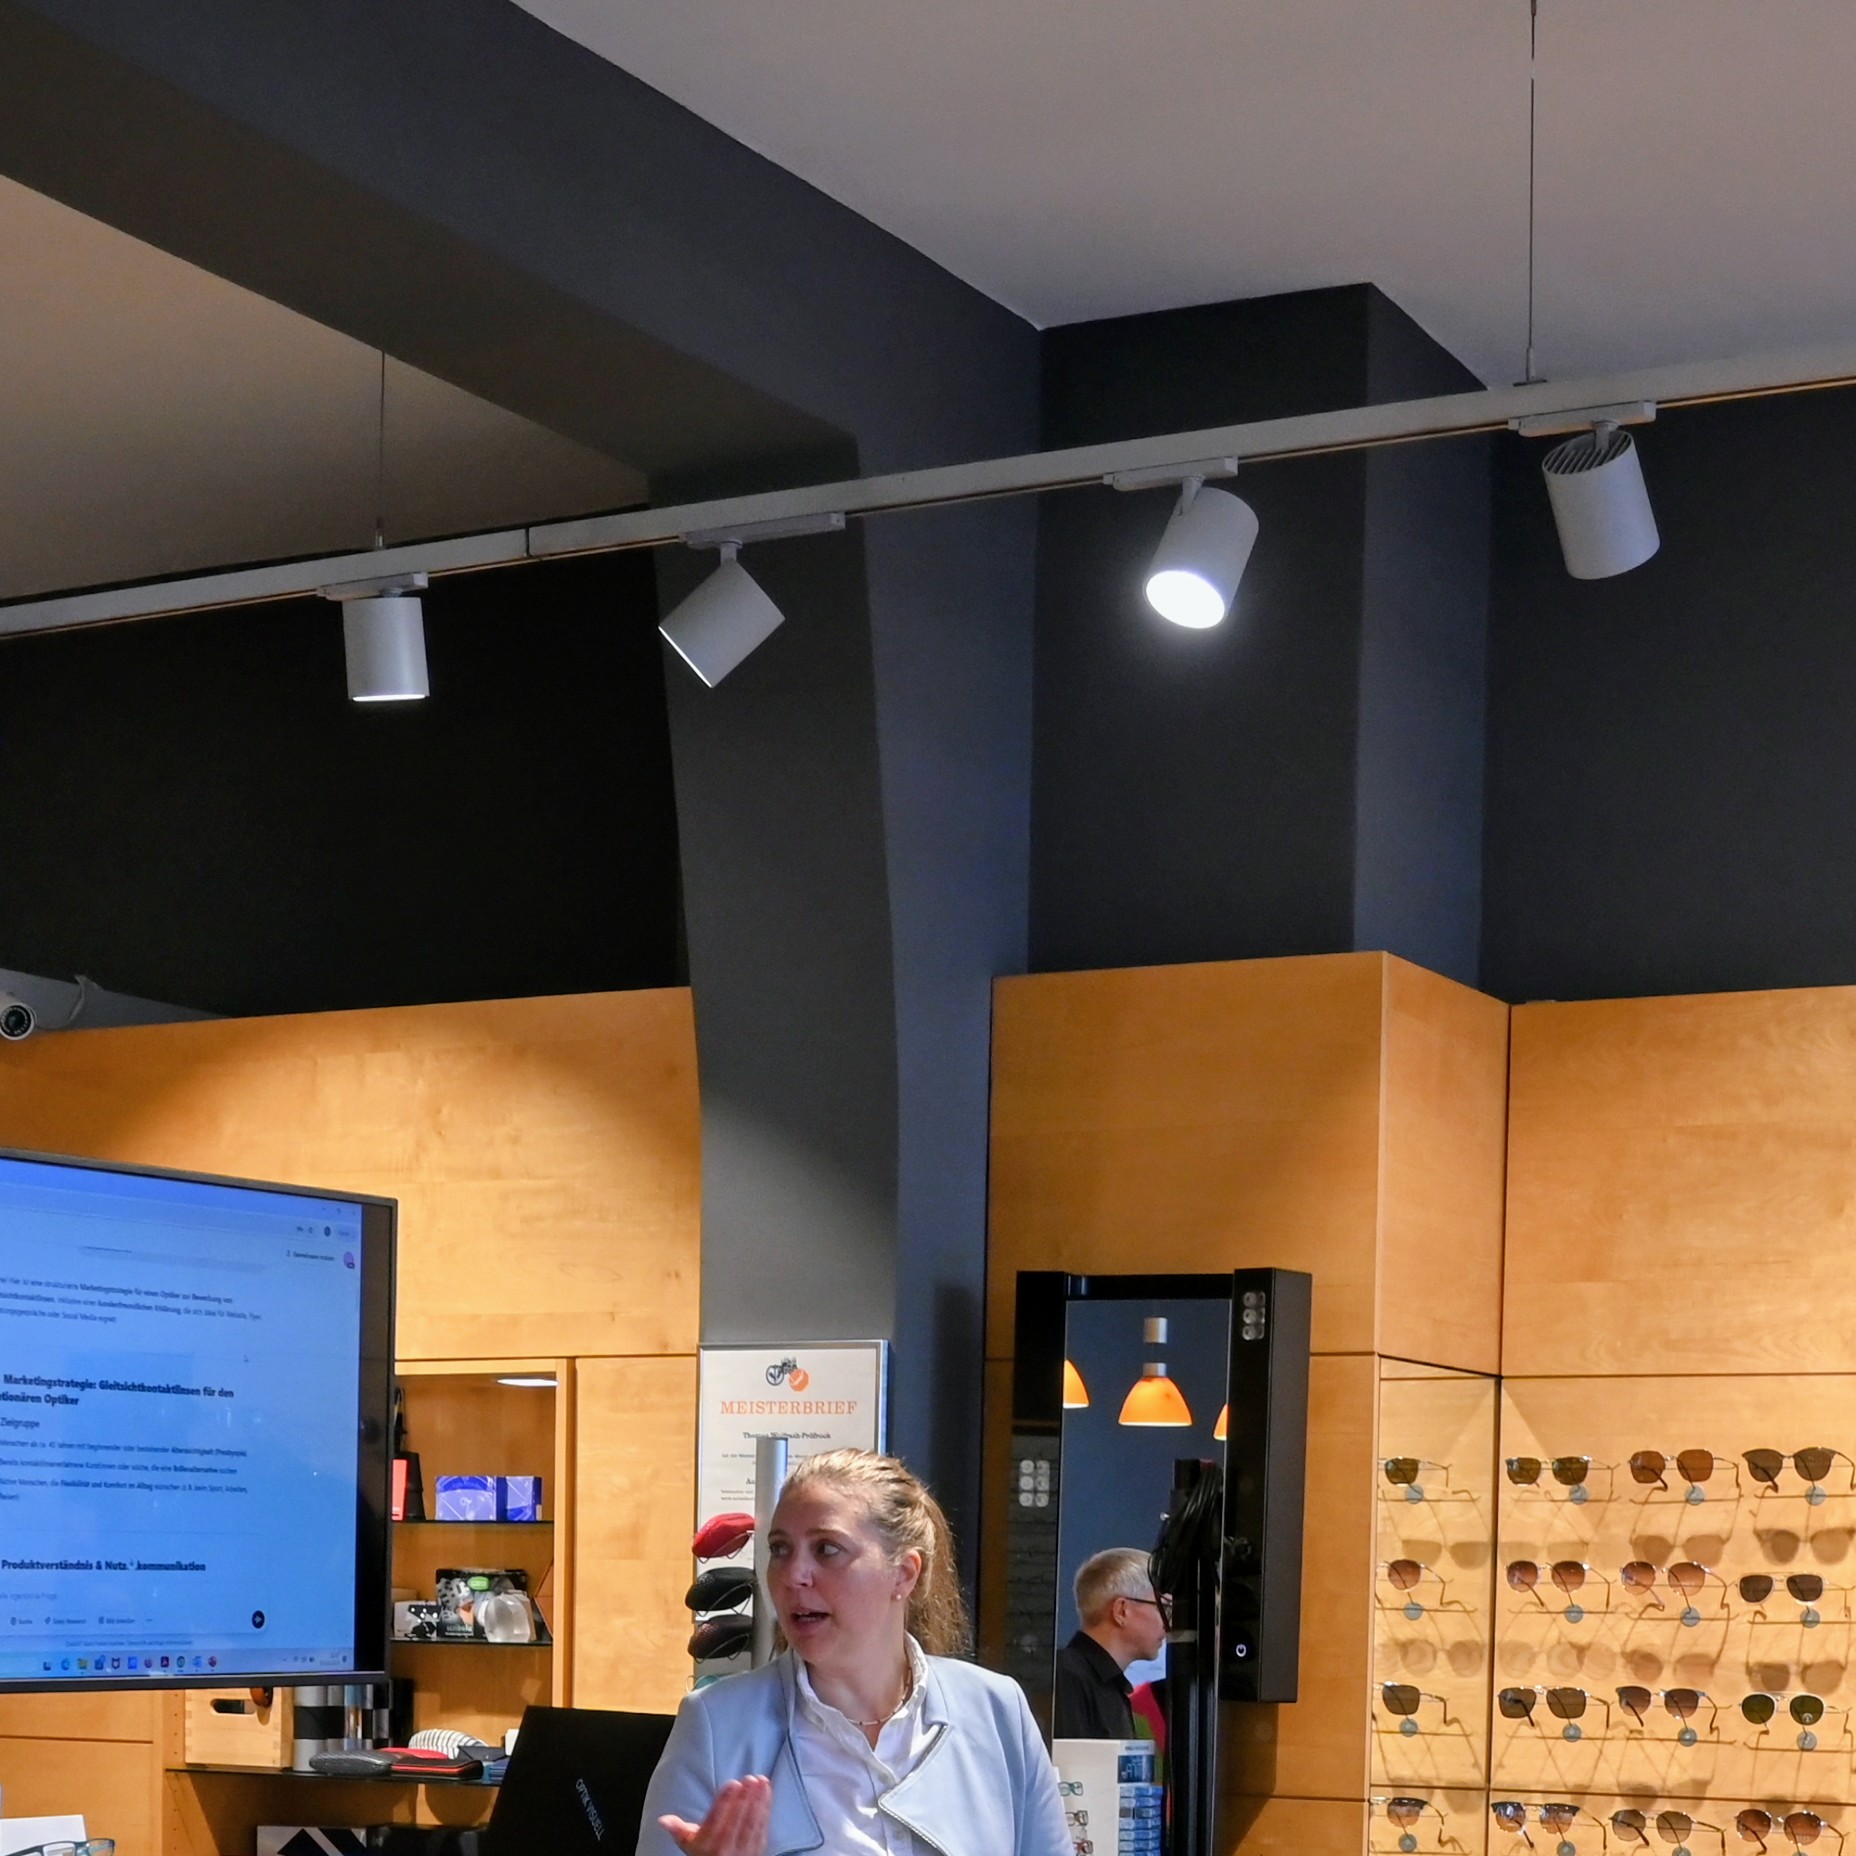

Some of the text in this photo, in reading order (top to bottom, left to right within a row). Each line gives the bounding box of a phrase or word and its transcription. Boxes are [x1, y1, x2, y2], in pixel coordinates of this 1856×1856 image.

[3, 1374, 233, 1399] Marketingstrategie: Gleitsichtkontaktlinsen für den
[43, 1393, 79, 1407] Optiker
[720, 1401, 858, 1415] MEISTERBRIEF
[0, 1417, 40, 1429] Zielgruppe
[1, 1559, 102, 1570] Produktverständnis &
